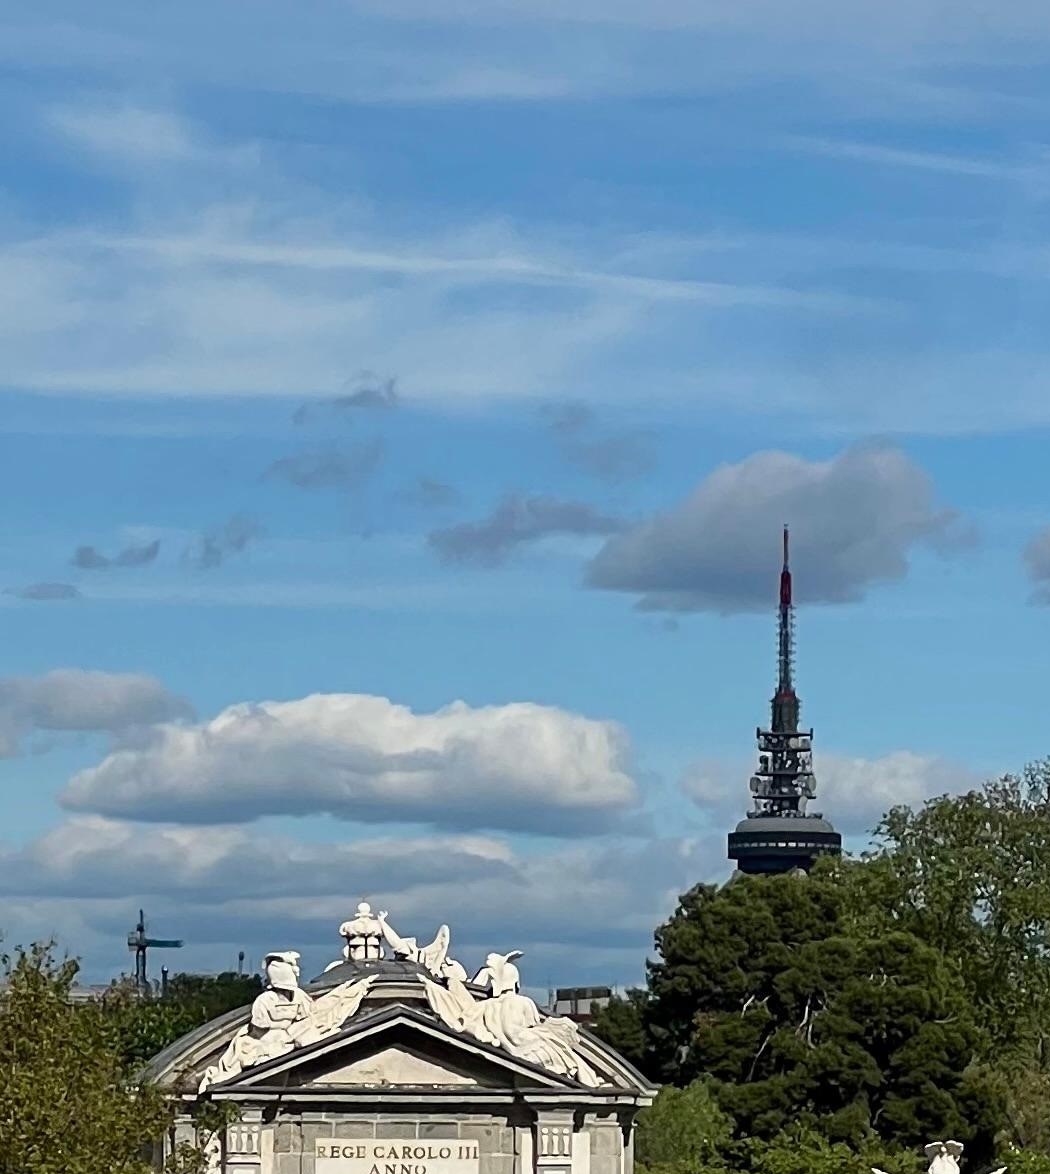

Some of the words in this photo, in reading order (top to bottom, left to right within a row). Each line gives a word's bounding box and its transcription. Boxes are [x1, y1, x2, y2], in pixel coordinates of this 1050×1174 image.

[316, 1145, 367, 1159] REGE
[373, 1145, 451, 1160] CAROLO
[458, 1145, 479, 1160] III
